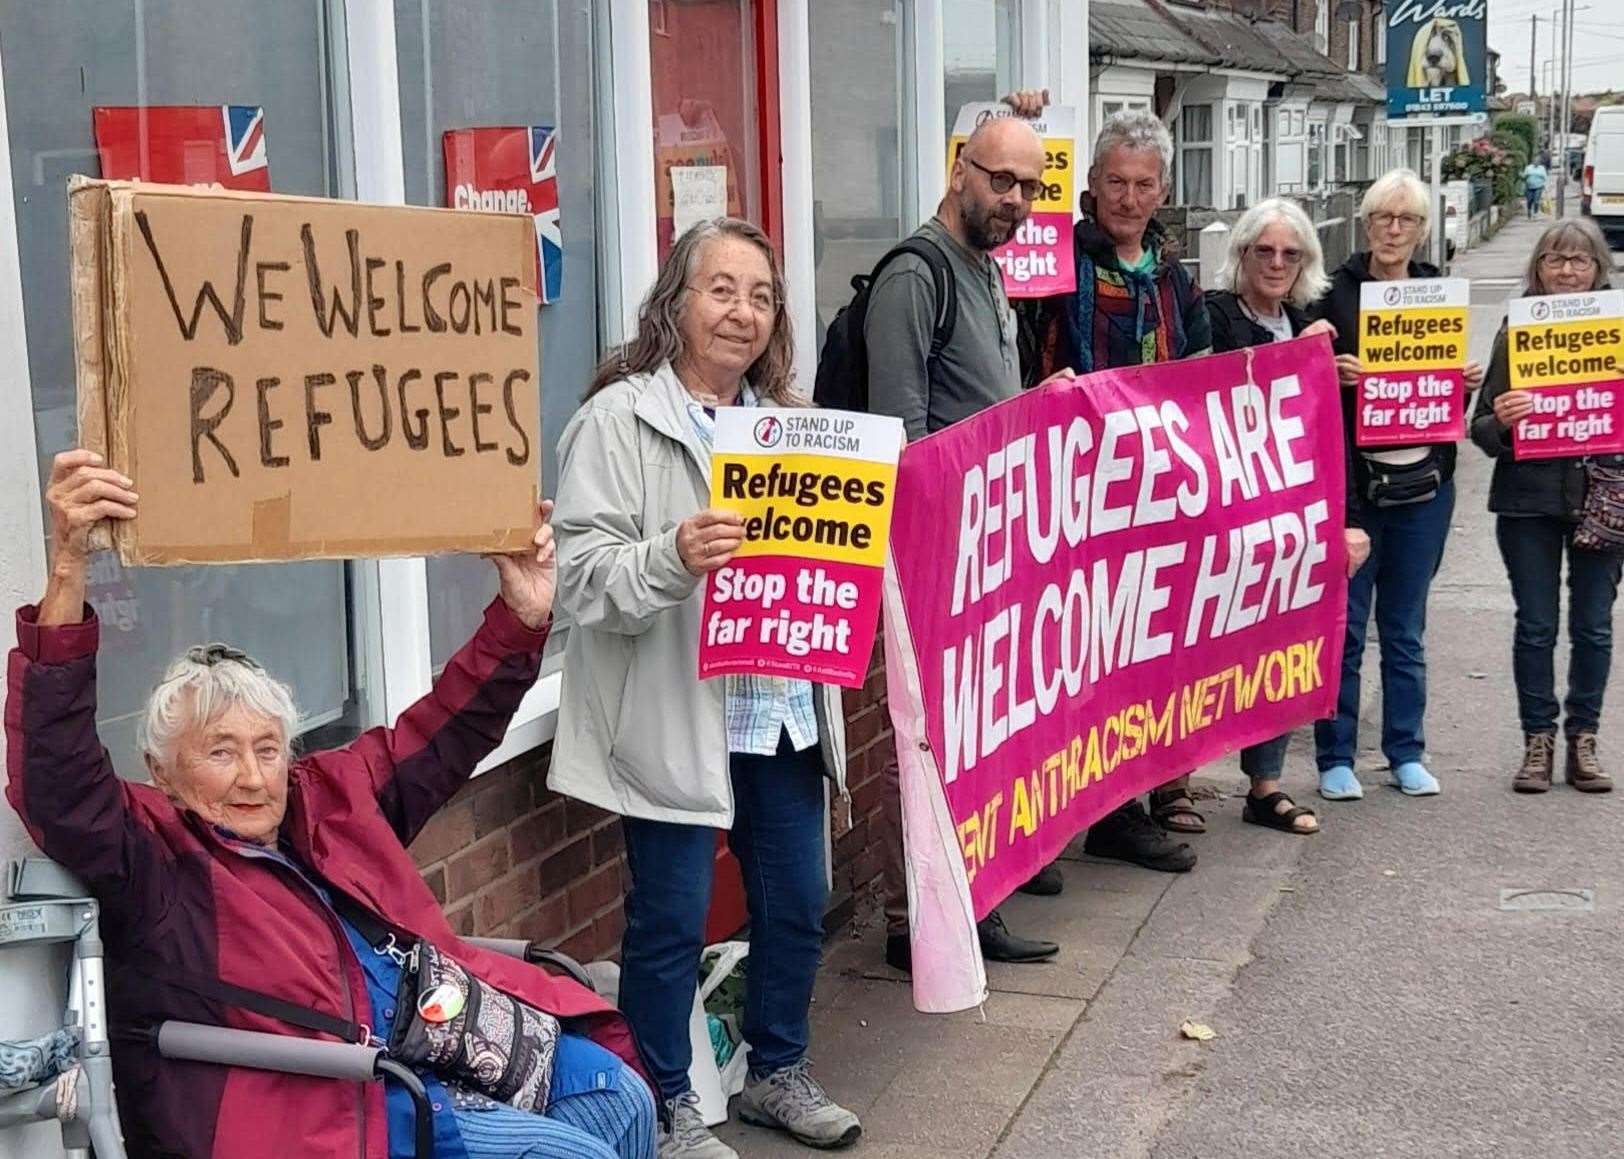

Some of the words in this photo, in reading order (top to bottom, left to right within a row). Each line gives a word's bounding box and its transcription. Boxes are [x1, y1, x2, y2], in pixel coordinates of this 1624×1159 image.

[1419, 87, 1454, 103] LET
[454, 184, 533, 215] Change.
[1015, 218, 1058, 246] the
[134, 211, 291, 345] WE
[300, 222, 523, 340] WELCOME
[994, 250, 1057, 282] right
[1403, 286, 1427, 295] STAND
[1430, 285, 1442, 294] UP
[1403, 296, 1413, 305] TO
[1415, 295, 1446, 305] RACISM
[1552, 299, 1580, 309] STAND
[1583, 297, 1595, 307] UP
[1366, 314, 1463, 340] Refugees
[1552, 309, 1564, 319] TO
[1566, 307, 1600, 318] RACISM
[1366, 341, 1457, 363] welcome
[1515, 328, 1621, 353] Refugees
[1517, 355, 1616, 378] welcome
[1363, 376, 1412, 403] Stop
[1417, 374, 1454, 397] the
[1532, 392, 1571, 417] top
[1576, 387, 1614, 410] the
[189, 365, 531, 484] REFUGEES
[786, 416, 829, 434] STAND
[834, 418, 855, 435] UP
[1362, 404, 1395, 427] far
[1399, 401, 1451, 429] right
[1518, 419, 1553, 441] far
[1557, 413, 1613, 442] right
[785, 435, 801, 449] TO
[804, 435, 860, 452] RACISM
[723, 463, 885, 507] Refugees
[950, 405, 1206, 617] REFUGEES
[1206, 374, 1316, 507] ARE
[741, 507, 872, 549] elcome
[712, 567, 787, 609] Stop
[797, 568, 859, 609] the
[707, 611, 752, 647] far
[760, 609, 852, 656] right
[943, 541, 1187, 784] WELCOME
[1183, 500, 1329, 648] HERE
[957, 793, 1004, 884] ENT
[1180, 636, 1325, 739] NETWORK
